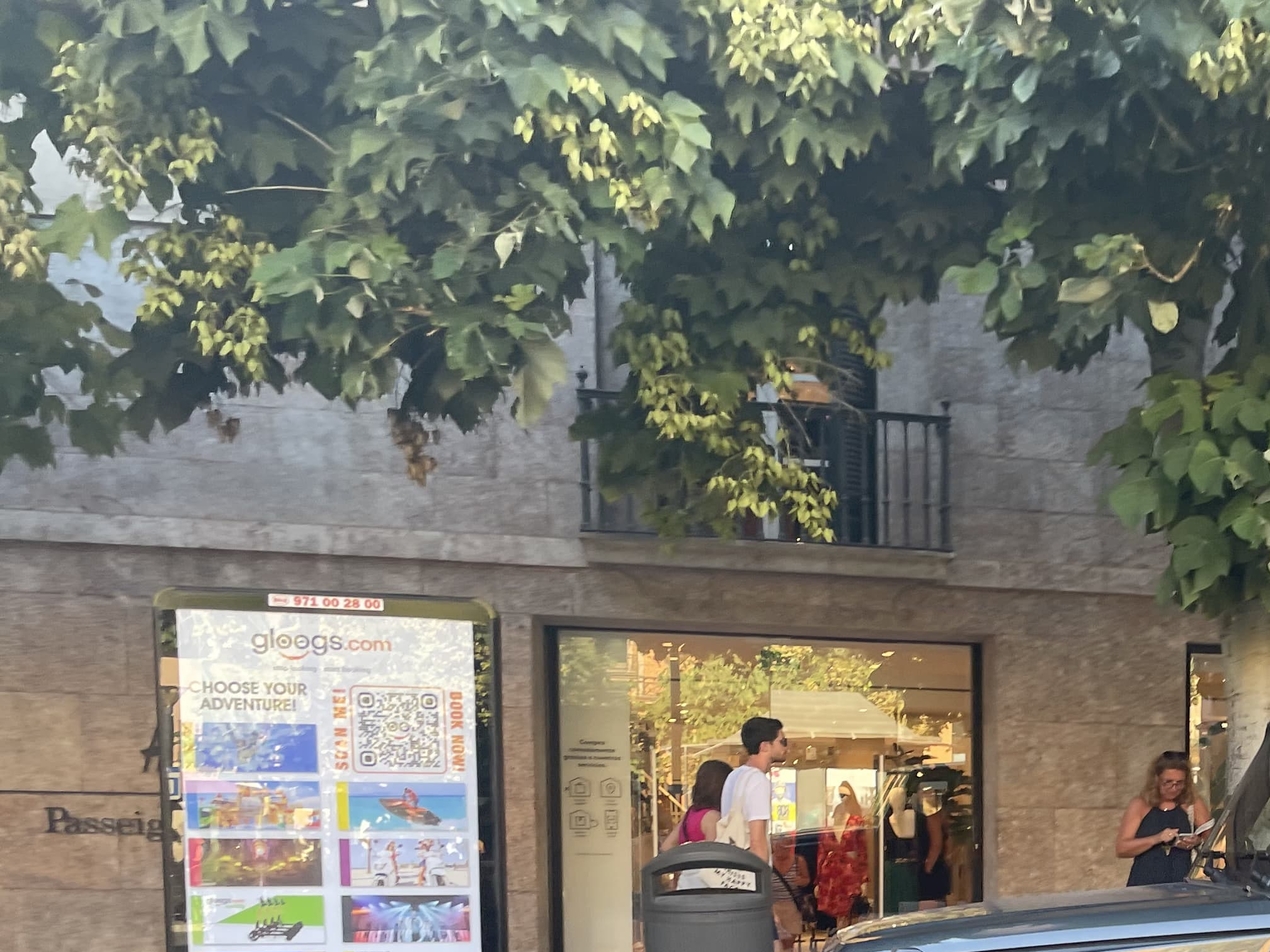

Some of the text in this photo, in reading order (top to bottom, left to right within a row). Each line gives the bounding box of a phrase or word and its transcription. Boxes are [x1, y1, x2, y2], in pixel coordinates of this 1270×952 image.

[293, 596, 318, 607] 971
[322, 598, 339, 608] 00
[343, 599, 360, 609] 28
[364, 600, 381, 610] 00
[251, 628, 392, 656] gloogs.com
[189, 680, 308, 696] CHOOSE YOUR
[200, 697, 297, 712] ADVENTURE!
[332, 689, 349, 770] SCAN ME!
[449, 691, 466, 771] BOOK NOW!
[44, 806, 163, 842] Passeig
